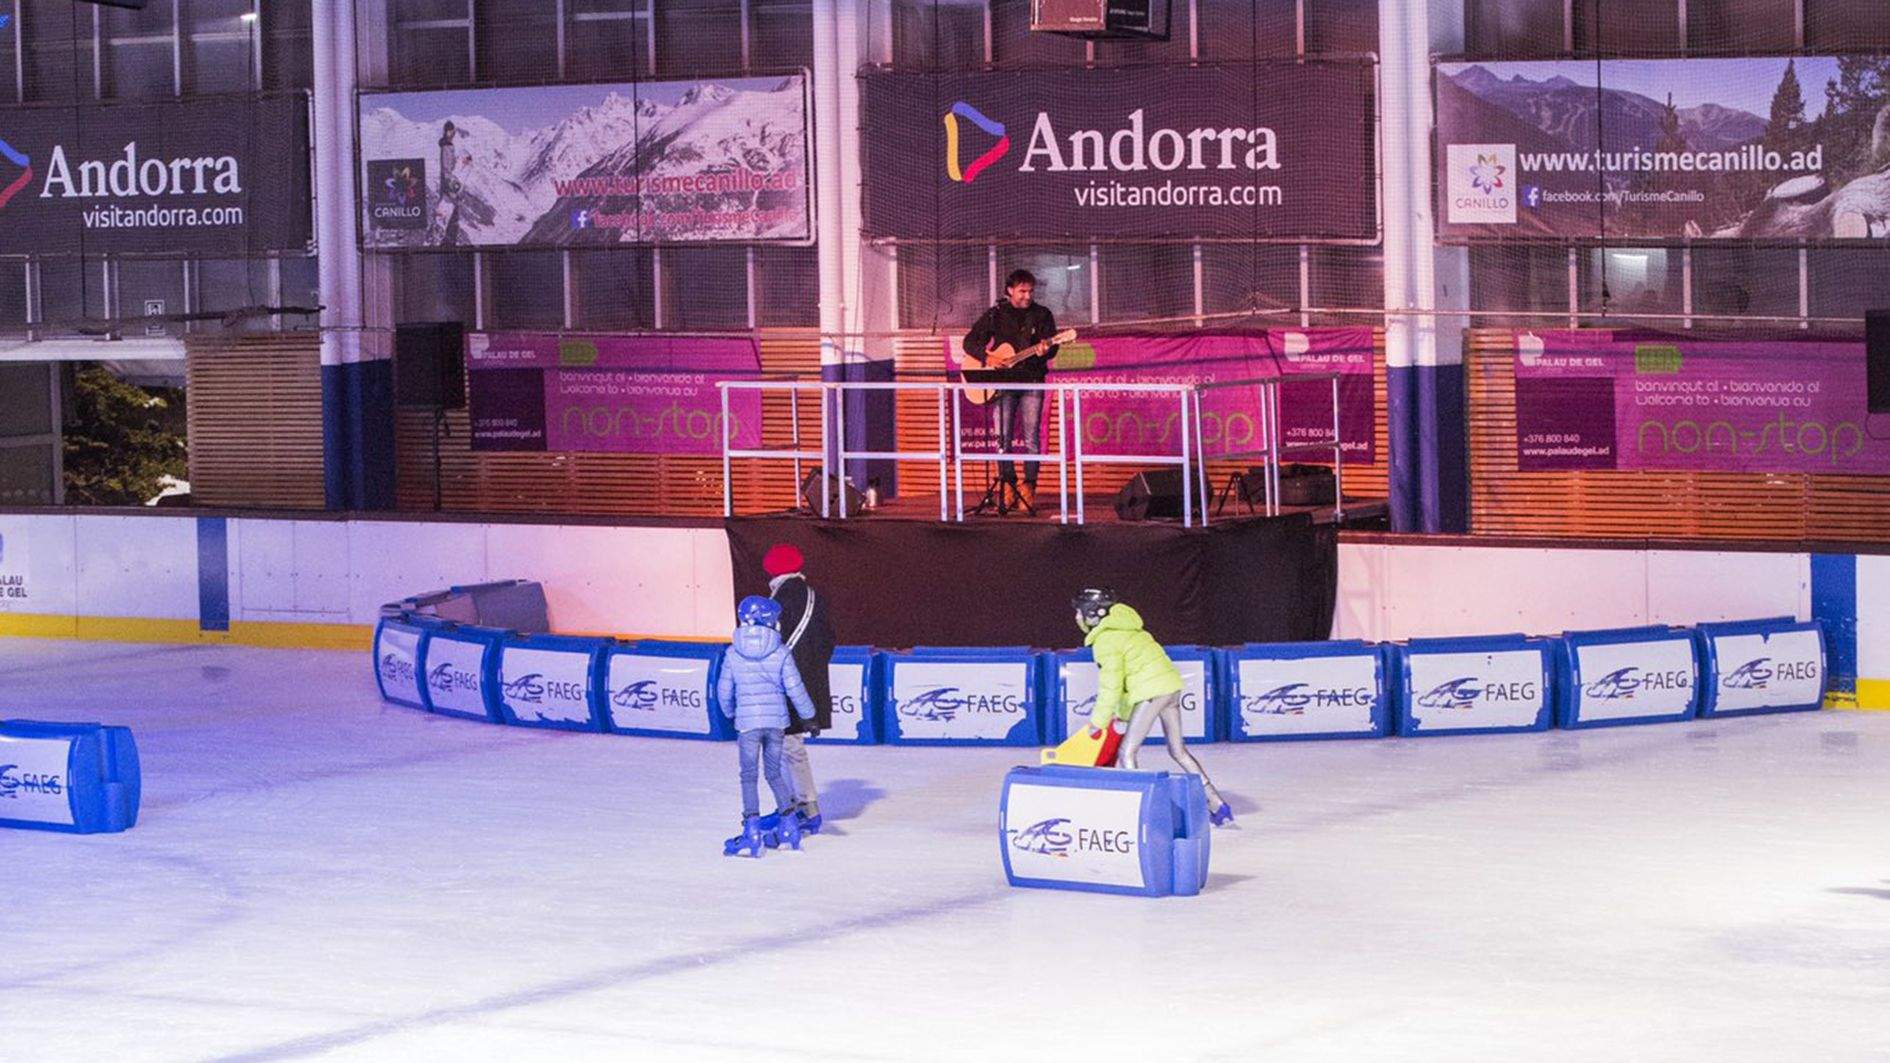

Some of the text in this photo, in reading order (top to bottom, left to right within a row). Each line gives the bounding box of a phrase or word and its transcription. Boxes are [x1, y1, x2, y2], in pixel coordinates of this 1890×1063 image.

[1018, 109, 1281, 172] Andorra
[40, 141, 242, 198] Andorra
[1519, 144, 1824, 174] www.turismecanillo.ad
[1074, 180, 1282, 206] visitandorra.com
[1456, 197, 1509, 209] CANILLO
[83, 204, 243, 228] visitandorra.com
[374, 206, 421, 218] CANILLO
[1301, 355, 1365, 363] PALAU DE GEL
[1536, 358, 1604, 367] PALAU DE GEL
[1697, 395, 1710, 405] to
[562, 400, 739, 449] non-stop
[1546, 434, 1562, 443] 800
[1563, 434, 1580, 443] 840
[1637, 411, 1864, 465] non-stop
[0, 575, 23, 586] LAU
[7, 587, 28, 598] GEL
[454, 670, 478, 691] FAEG
[1644, 670, 1688, 690] FAEG
[1776, 661, 1817, 682] FAEG
[547, 681, 582, 702] FAEG
[661, 688, 701, 709] FAEG
[1317, 688, 1369, 707] FAEG
[1485, 683, 1535, 702] FAEG
[967, 694, 1018, 713] FAEG
[22, 773, 62, 795] FAEG
[1079, 828, 1131, 853] FAEG
